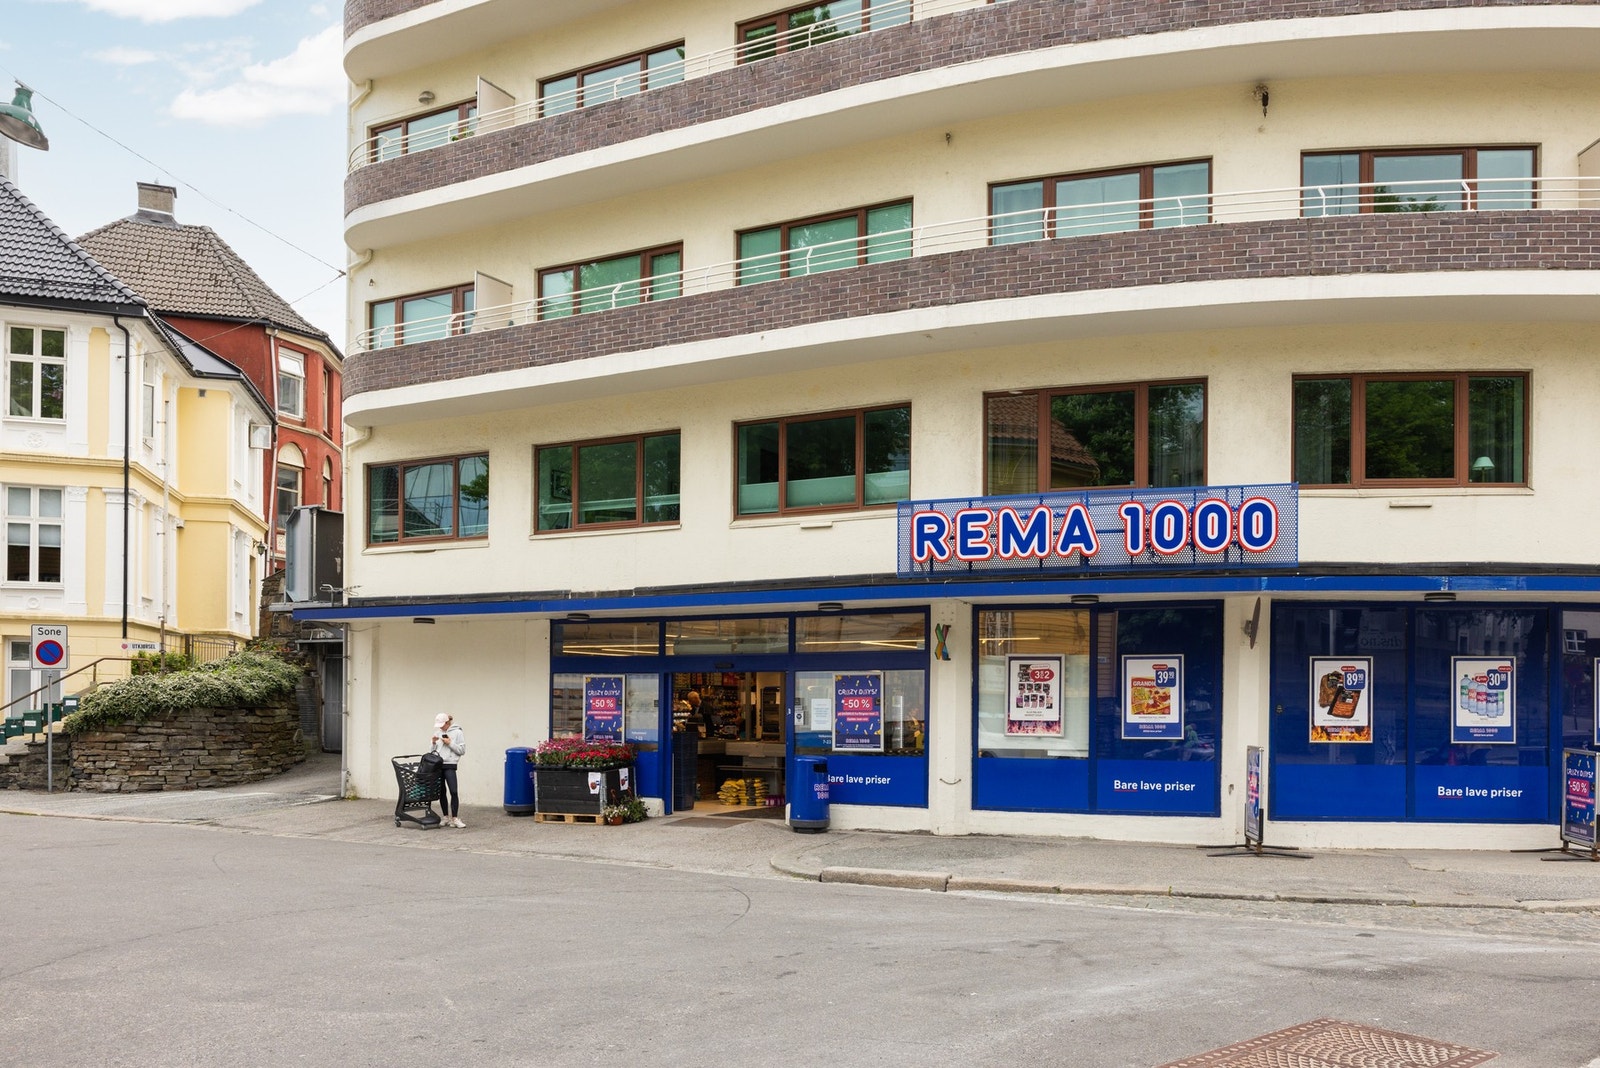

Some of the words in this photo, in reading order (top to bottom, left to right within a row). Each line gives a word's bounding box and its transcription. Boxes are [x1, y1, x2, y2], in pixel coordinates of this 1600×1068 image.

[911, 502, 1100, 563] REMA
[1119, 496, 1280, 557] 1000
[37, 626, 62, 636] Sone
[1034, 670, 1040, 679] 3
[1044, 670, 1050, 679] 2
[1157, 670, 1169, 684] 39
[1346, 673, 1358, 686] 89
[1488, 673, 1500, 686] 30
[845, 774, 864, 783] lave
[865, 774, 891, 785] priser
[1113, 779, 1138, 790] Bare
[1140, 779, 1162, 791] lave
[1164, 780, 1195, 792] priser
[1437, 785, 1463, 796] Bare
[1465, 786, 1488, 797] lave
[1490, 786, 1522, 799] priser
